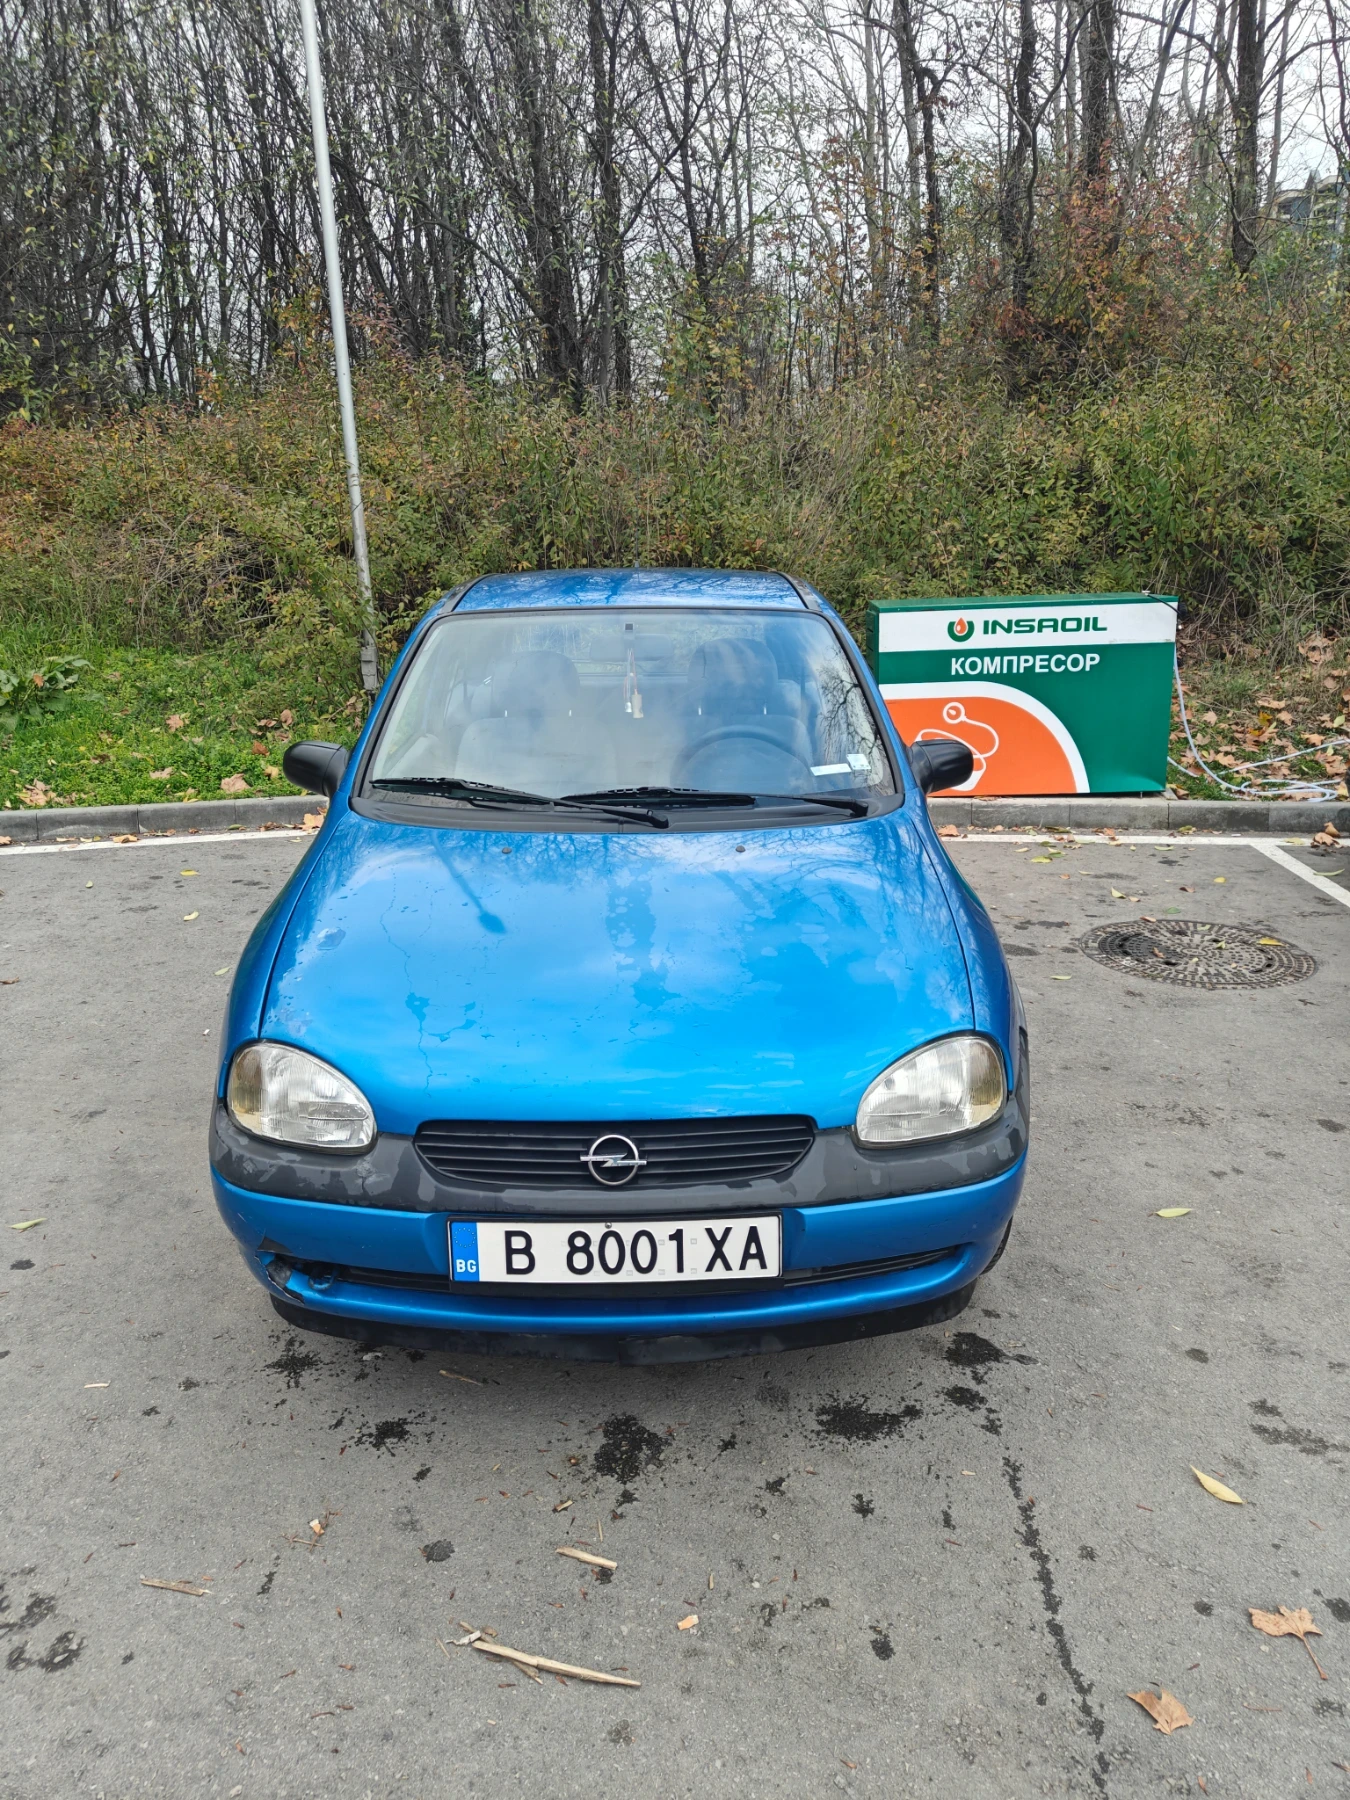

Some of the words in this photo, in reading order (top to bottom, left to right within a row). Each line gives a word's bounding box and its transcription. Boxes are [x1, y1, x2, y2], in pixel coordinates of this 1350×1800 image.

[983, 617, 1107, 635] INSAOIL
[951, 653, 1100, 675] КОМПРЕСОР
[504, 1230, 536, 1275] B
[566, 1228, 685, 1275] 8001
[704, 1225, 768, 1273] XA
[456, 1259, 477, 1273] BG
